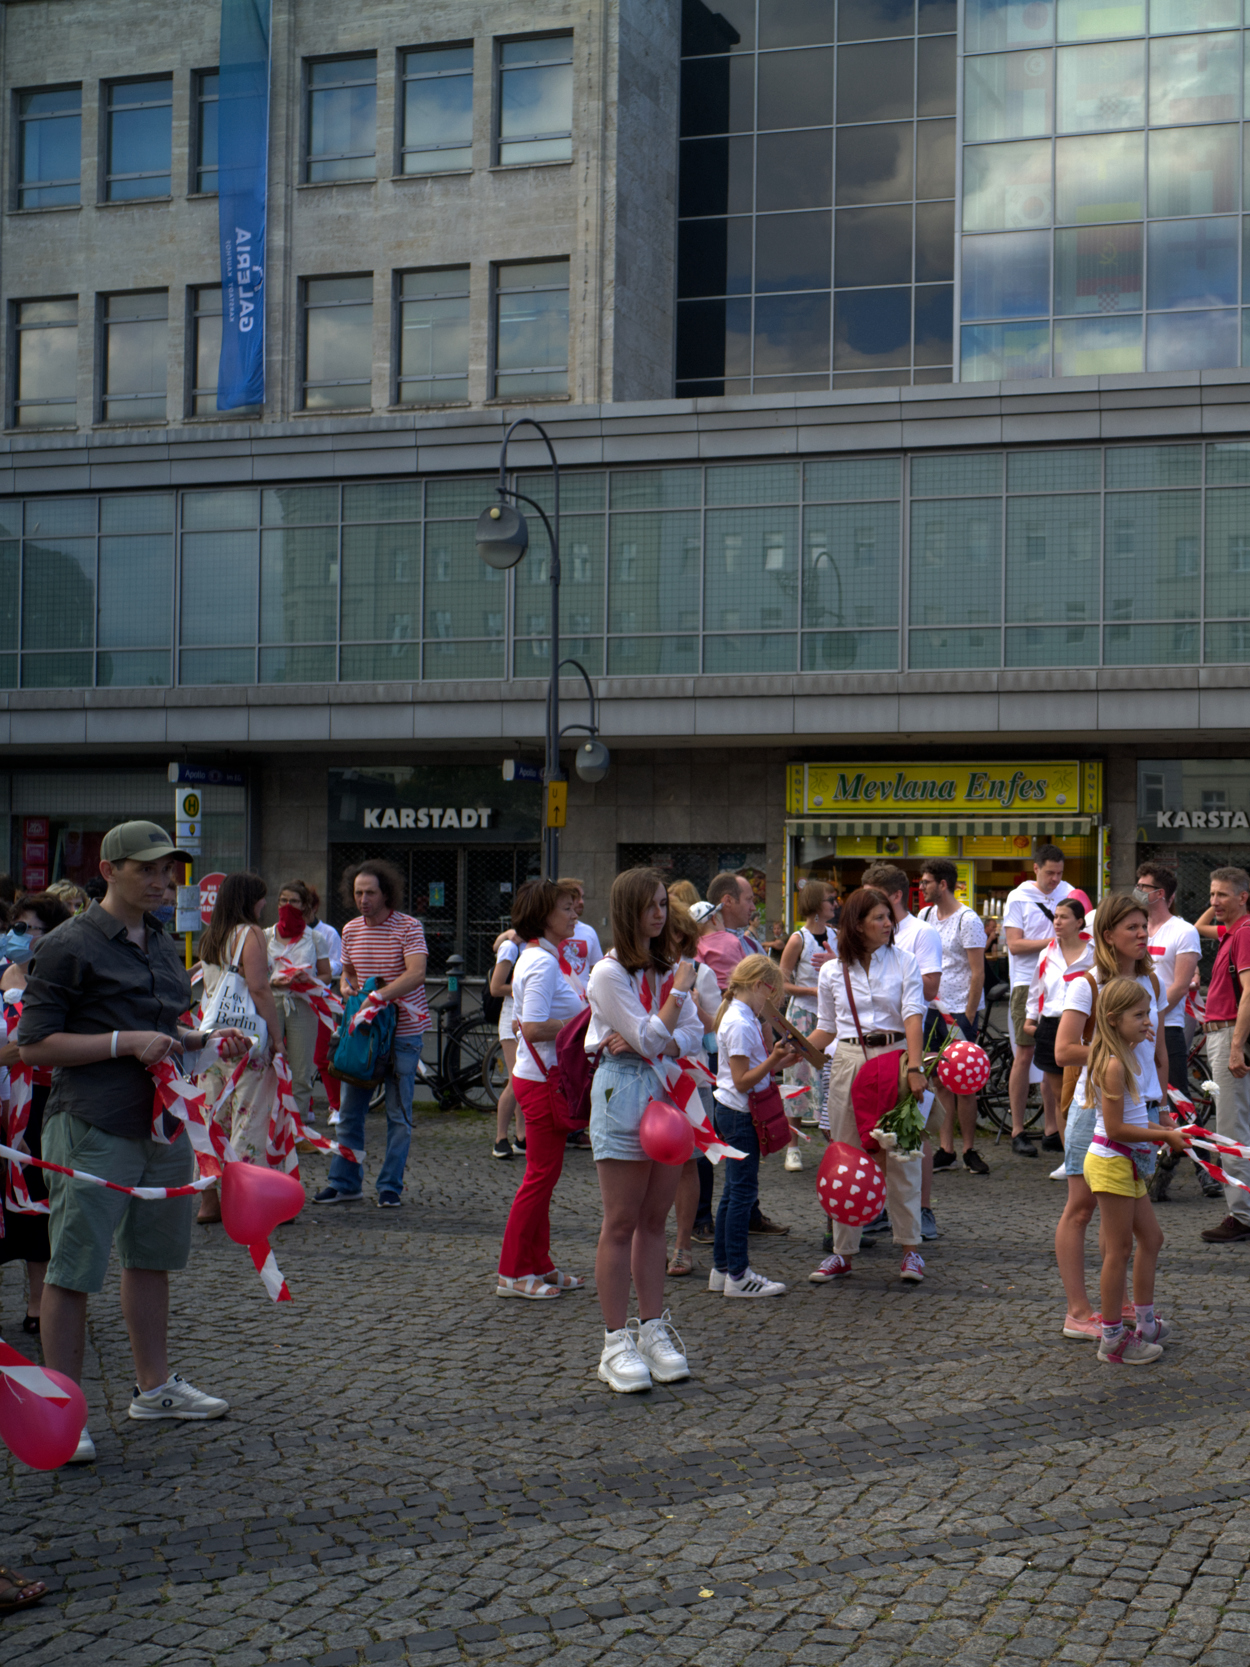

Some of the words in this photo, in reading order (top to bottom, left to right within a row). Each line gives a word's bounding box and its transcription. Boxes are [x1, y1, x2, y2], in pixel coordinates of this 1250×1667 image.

[185, 769, 206, 780] Apollo
[552, 788, 558, 798] U
[831, 771, 956, 801] Mevlana
[964, 770, 1048, 806] Enfes
[1088, 763, 1096, 810] KONYA
[364, 807, 492, 829] KARSTADT
[223, 986, 245, 1004] Lov
[219, 998, 231, 1010] is
[233, 1000, 245, 1014] in
[215, 1010, 257, 1031] Berlin
